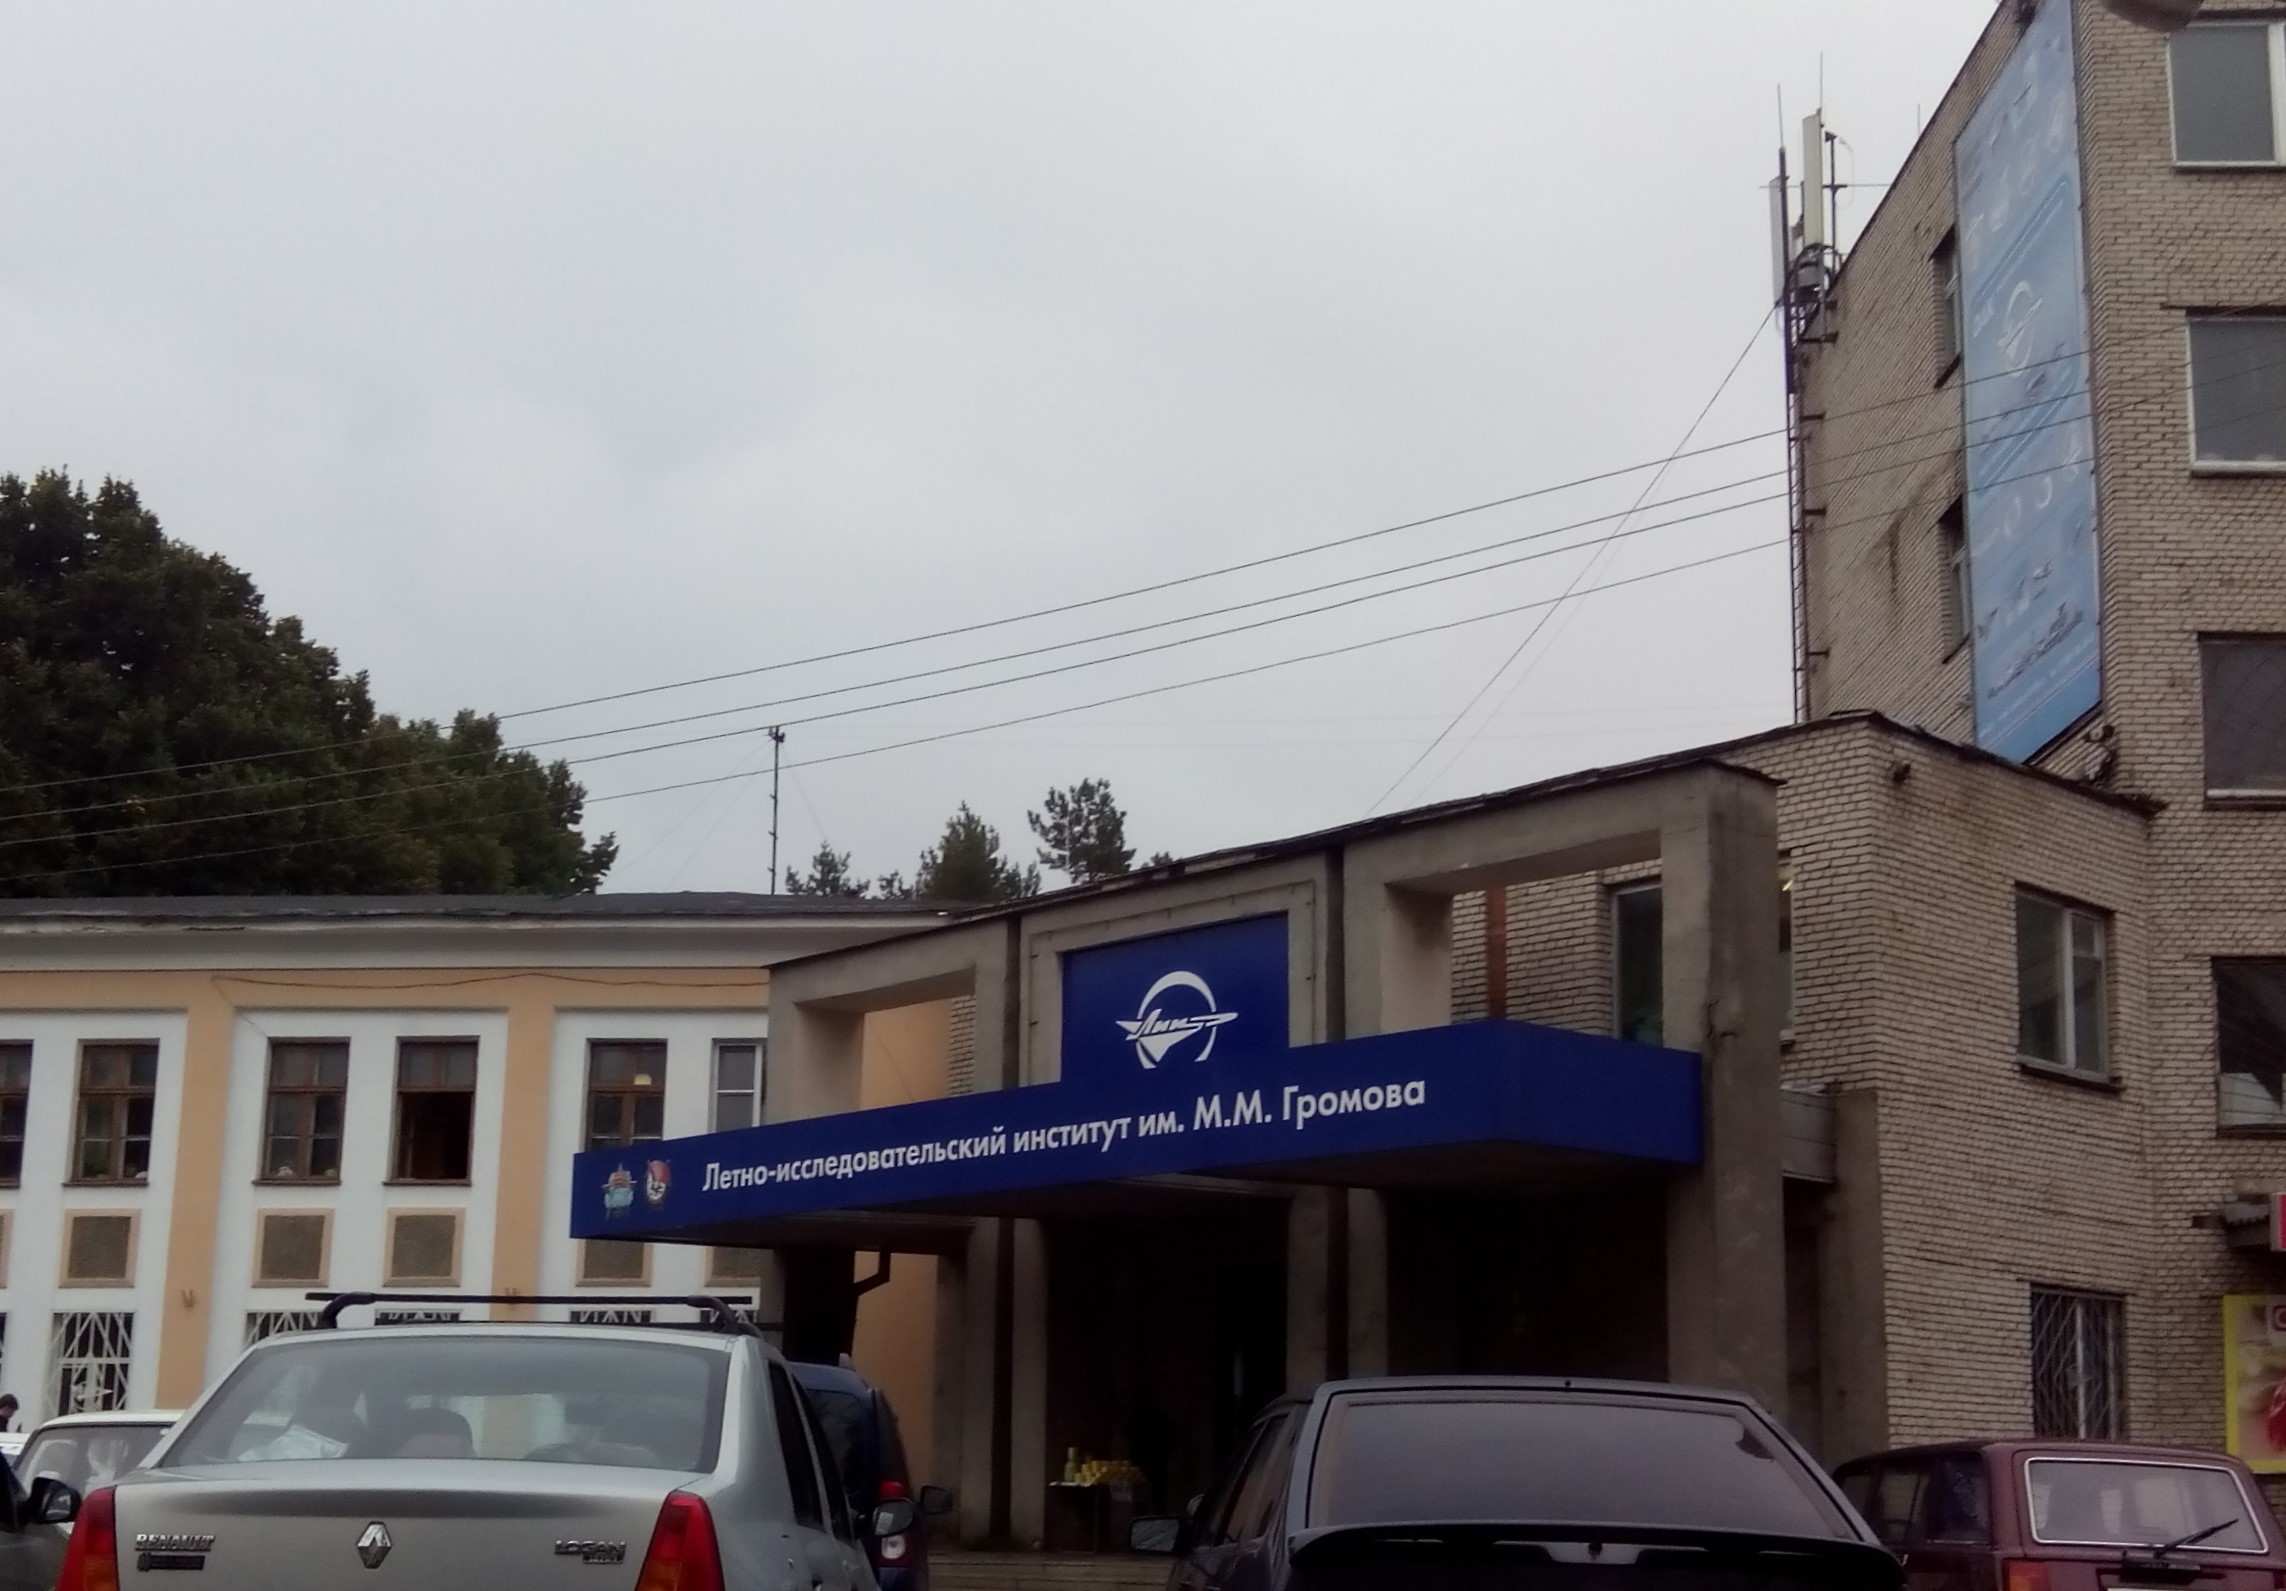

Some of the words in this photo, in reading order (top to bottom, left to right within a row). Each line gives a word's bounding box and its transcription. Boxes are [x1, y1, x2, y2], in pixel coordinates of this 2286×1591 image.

[702, 1125, 1006, 1191] Летно-исследовательский
[1013, 1117, 1131, 1152] институт
[1138, 1111, 1185, 1137] им.
[1193, 1089, 1272, 1131] М.М.
[1283, 1080, 1426, 1130] Громова
[135, 1533, 216, 1551] RENAULT
